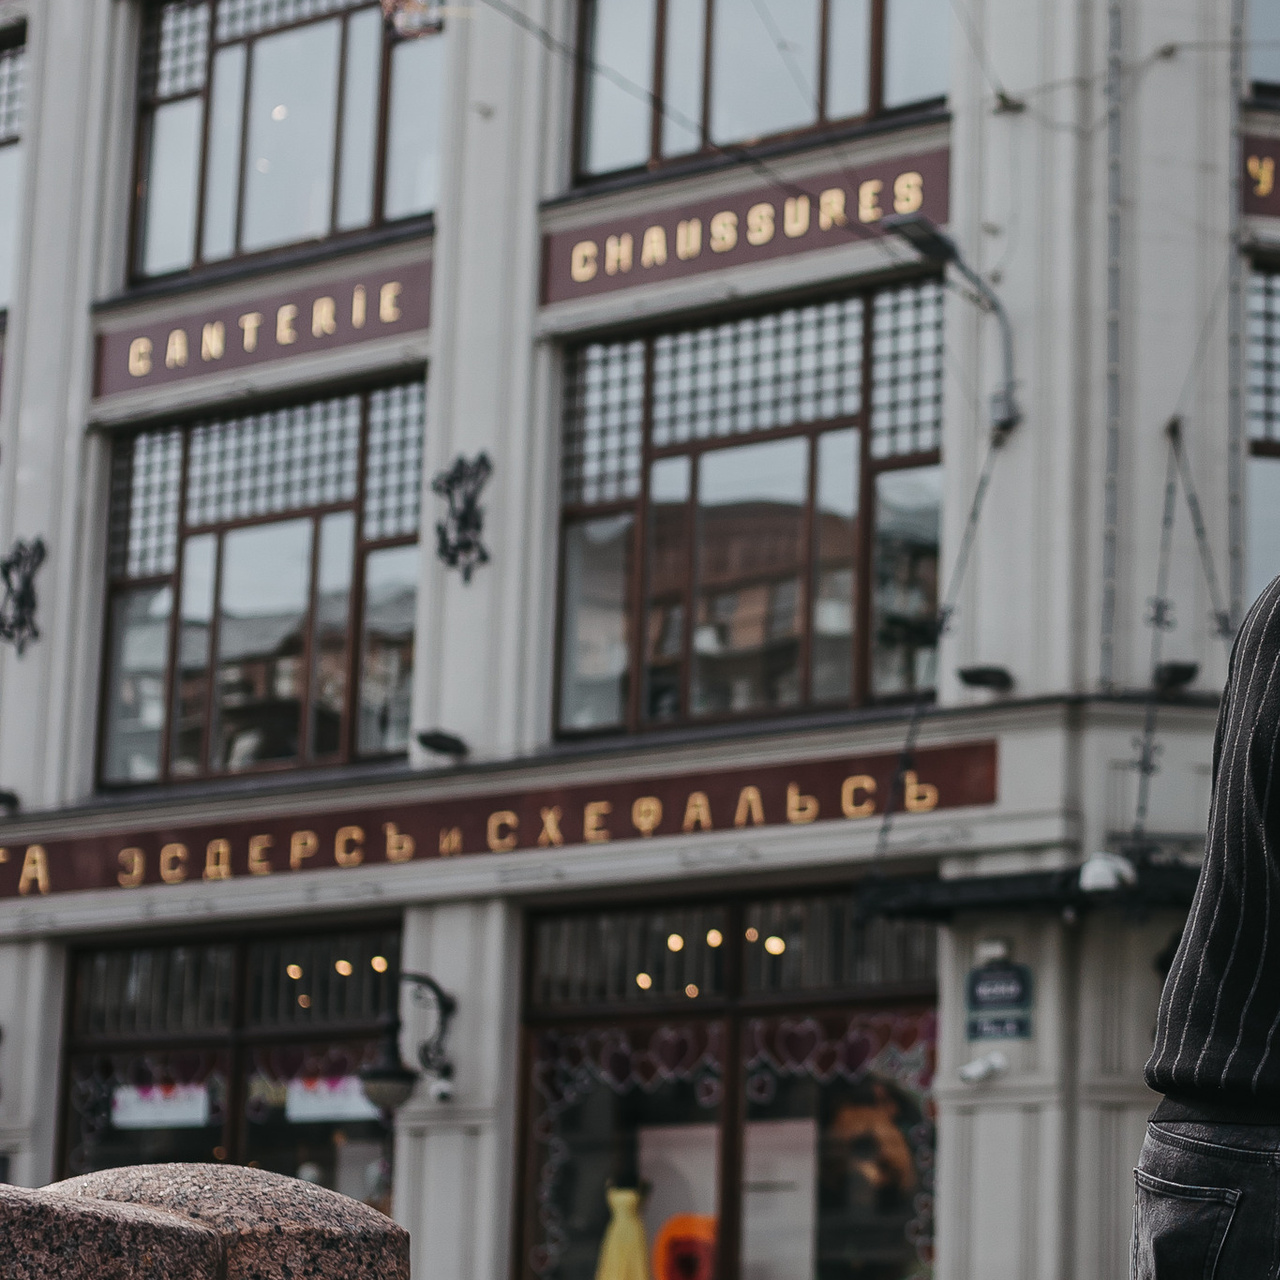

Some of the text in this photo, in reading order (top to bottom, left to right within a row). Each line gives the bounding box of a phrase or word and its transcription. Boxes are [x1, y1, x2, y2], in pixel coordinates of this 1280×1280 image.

[1246, 155, 1276, 198] У
[570, 171, 924, 283] CHAUSSURES
[117, 821, 417, 889] ЭСДЕРСЪ
